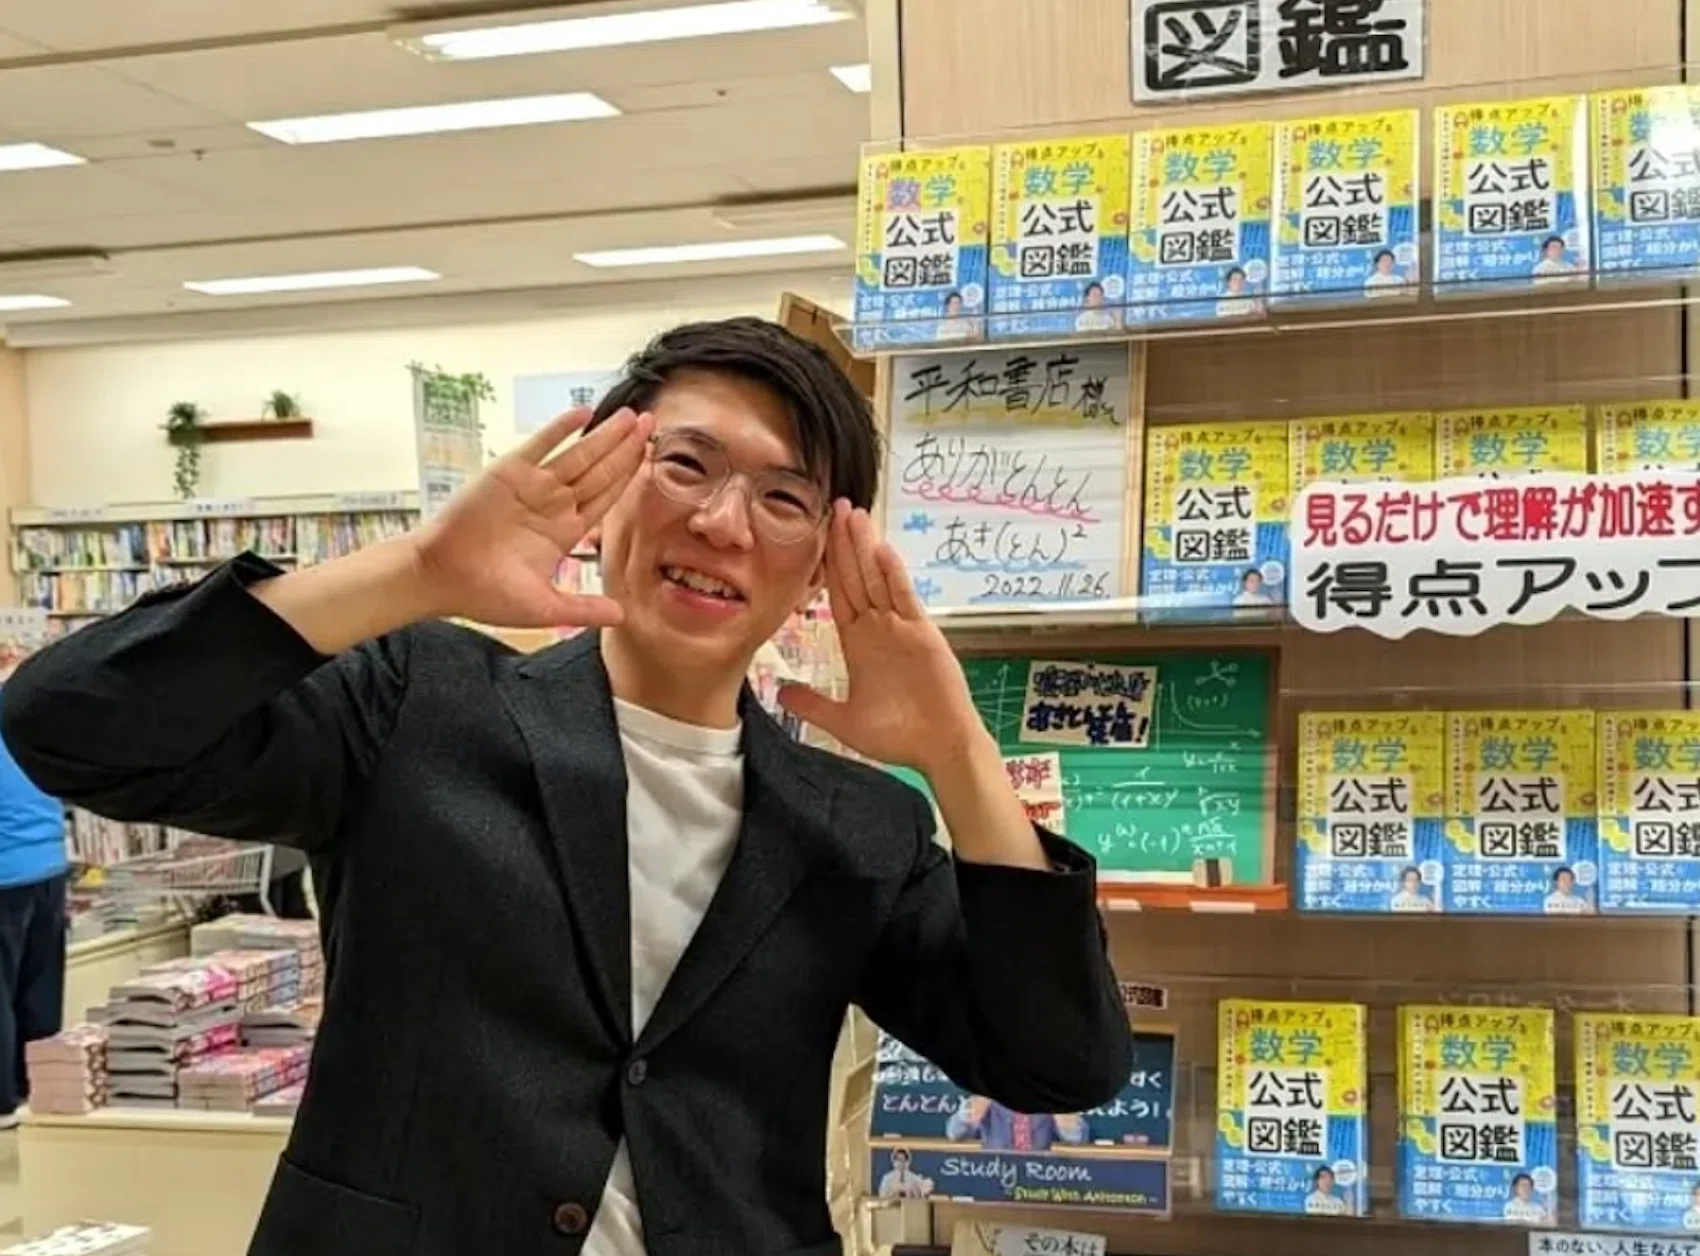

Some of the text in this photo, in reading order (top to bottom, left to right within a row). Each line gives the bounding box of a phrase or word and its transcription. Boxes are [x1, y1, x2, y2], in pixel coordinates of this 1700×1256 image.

[1145, 0, 1409, 89] 図鑑
[1307, 136, 1384, 169] 数学
[1468, 121, 1549, 158] 数学
[1024, 161, 1096, 198] 数学
[1164, 149, 1237, 184] 数学
[1468, 159, 1550, 195] 公式
[888, 174, 956, 209] 数学
[1162, 186, 1236, 224] 公式
[1306, 172, 1383, 209] 公式
[886, 211, 955, 247] 公式
[1022, 200, 1094, 237] 公式
[1304, 215, 1382, 247] 図鑑
[1468, 200, 1549, 234] 図鑑
[1021, 244, 1093, 278] 図鑑
[1160, 228, 1234, 264] 図鑑
[884, 252, 954, 287] 図鑑
[1180, 447, 1253, 482] 数学
[1320, 438, 1398, 474] 数学
[1470, 431, 1549, 467] 数学
[902, 431, 1094, 513] ありがとんとん
[1177, 486, 1252, 522] 公式
[1176, 528, 1251, 563] 図鑑
[1332, 735, 1408, 772] 数学
[1480, 736, 1558, 772] 数学
[1331, 777, 1409, 813] 公式
[1480, 777, 1560, 814] 公式
[1330, 822, 1409, 858] 図鑑
[1480, 821, 1560, 858] 図鑑
[1250, 1028, 1323, 1065] 数学
[1441, 1033, 1518, 1071] 数学
[1612, 1042, 1694, 1078] 数学
[1249, 1070, 1323, 1109] 公式
[1441, 1077, 1520, 1116] 公式
[1613, 1083, 1696, 1124] 公式
[1249, 1116, 1323, 1156] 図鑑
[1441, 1124, 1520, 1163] 図鑑
[1615, 1131, 1697, 1170] 図鑑
[939, 1154, 1093, 1188] Study Room
